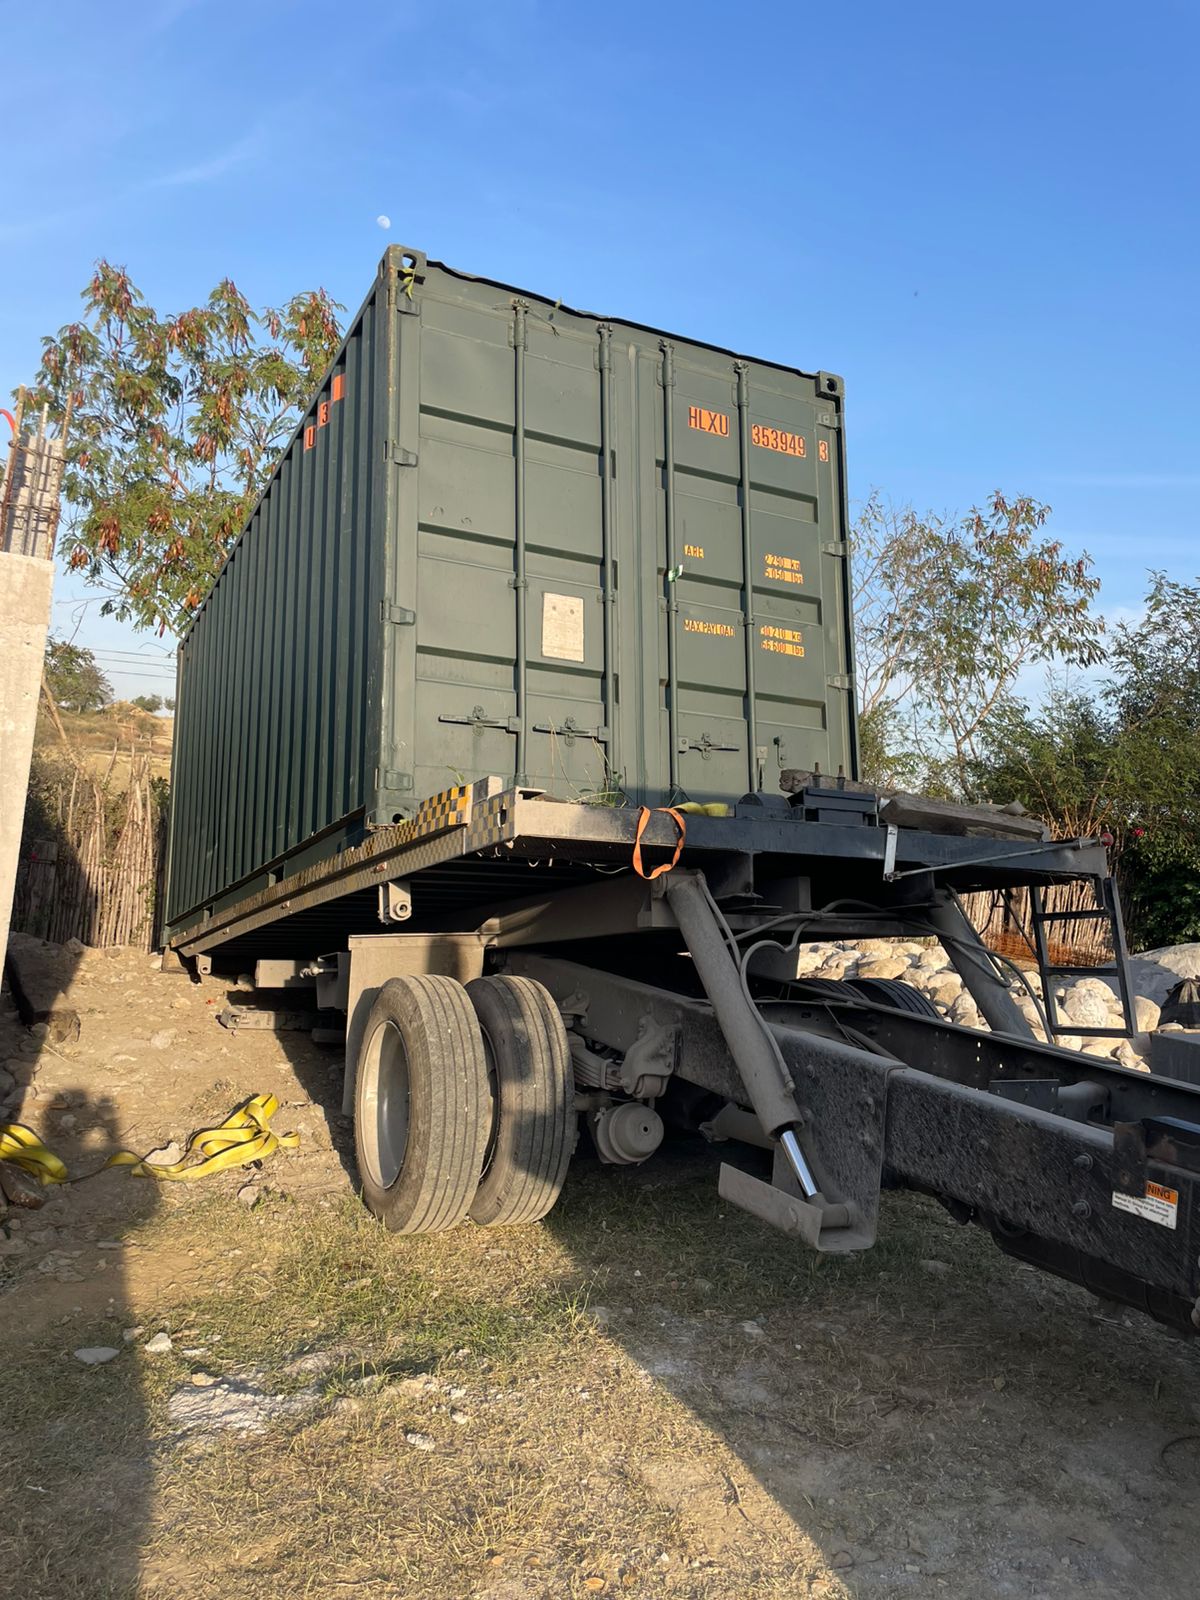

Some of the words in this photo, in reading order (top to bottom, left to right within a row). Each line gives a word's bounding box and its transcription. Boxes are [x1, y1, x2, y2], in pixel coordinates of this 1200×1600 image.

[688, 406, 729, 436] HLXU
[752, 424, 806, 457] 353949
[819, 441, 828, 461] 3
[1147, 1184, 1171, 1200] NING
